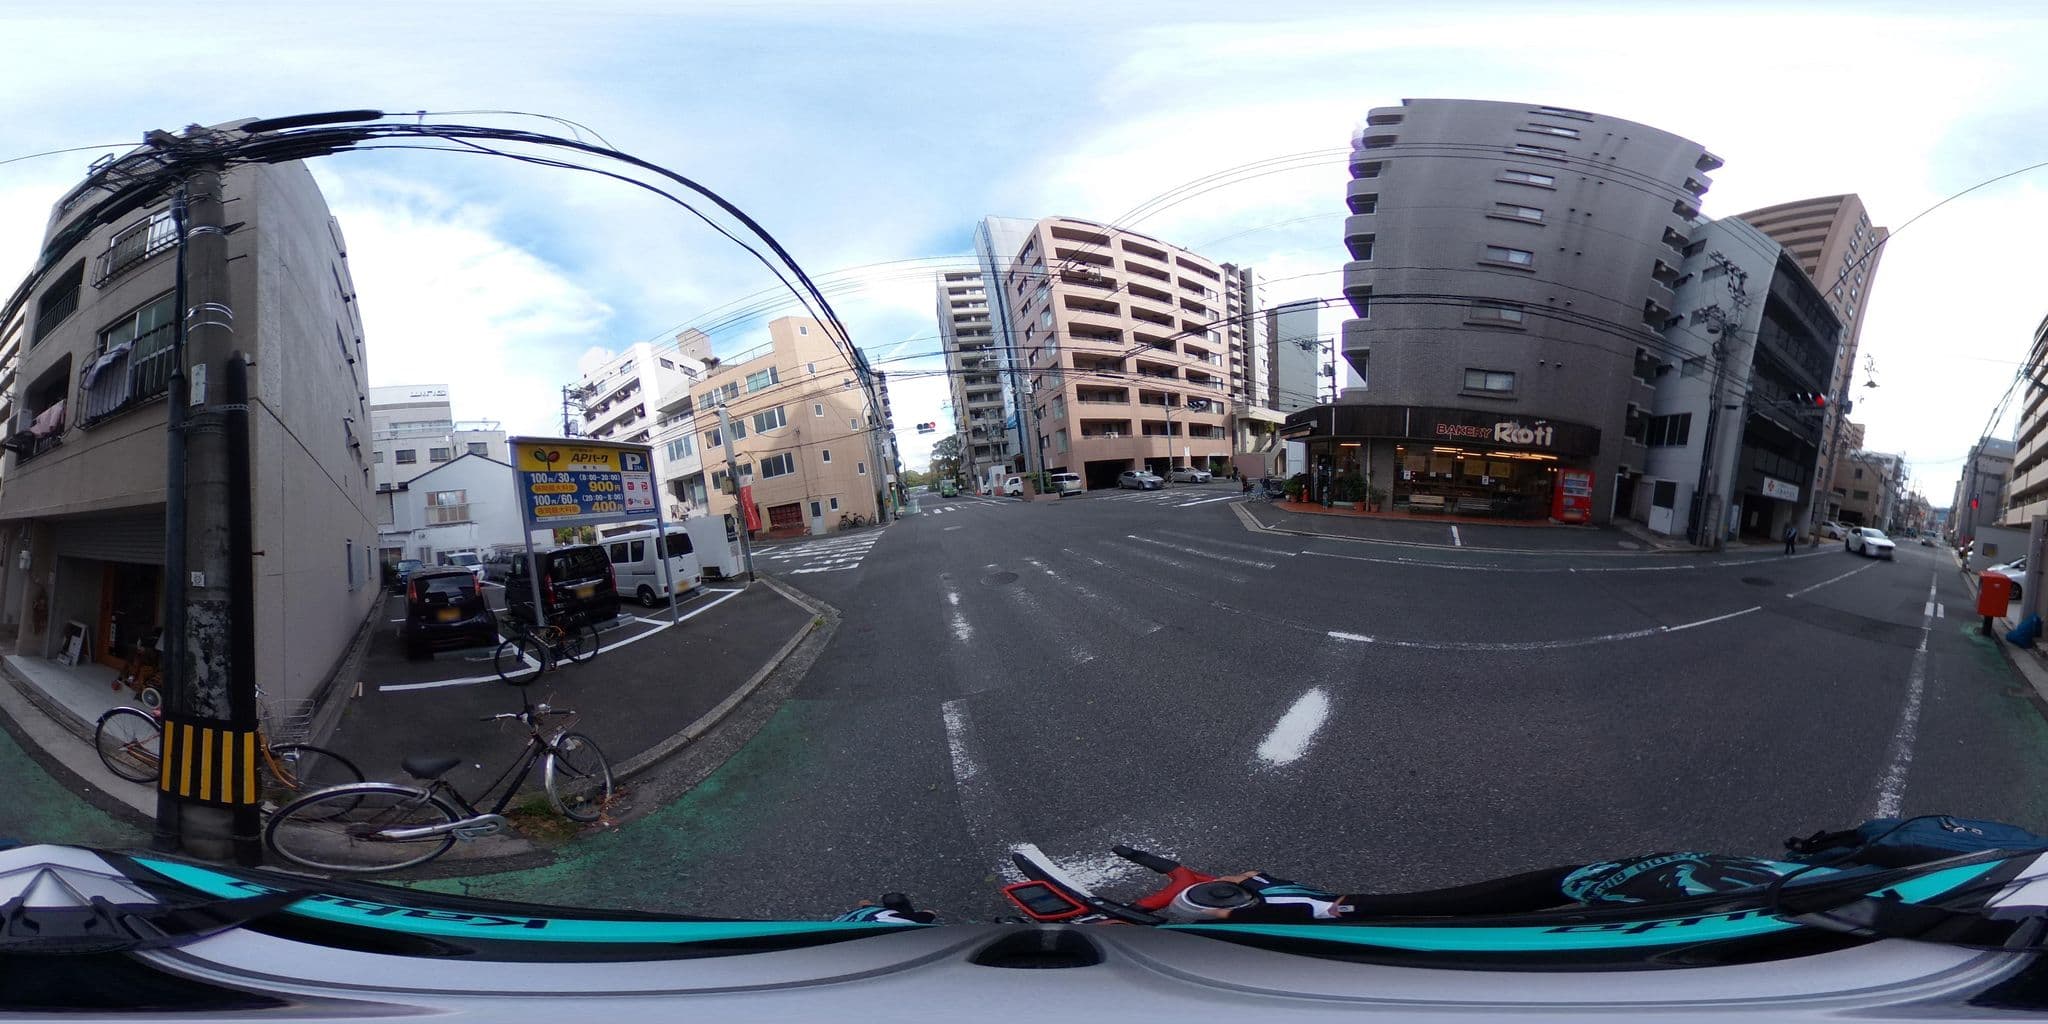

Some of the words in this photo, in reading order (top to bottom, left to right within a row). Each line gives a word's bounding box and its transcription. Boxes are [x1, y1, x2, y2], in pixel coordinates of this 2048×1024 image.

[1436, 424, 1492, 438] BAKERY
[571, 453, 608, 463] APパーク
[626, 454, 641, 471] P
[589, 481, 621, 492] 900円
[592, 501, 624, 512] 400円
